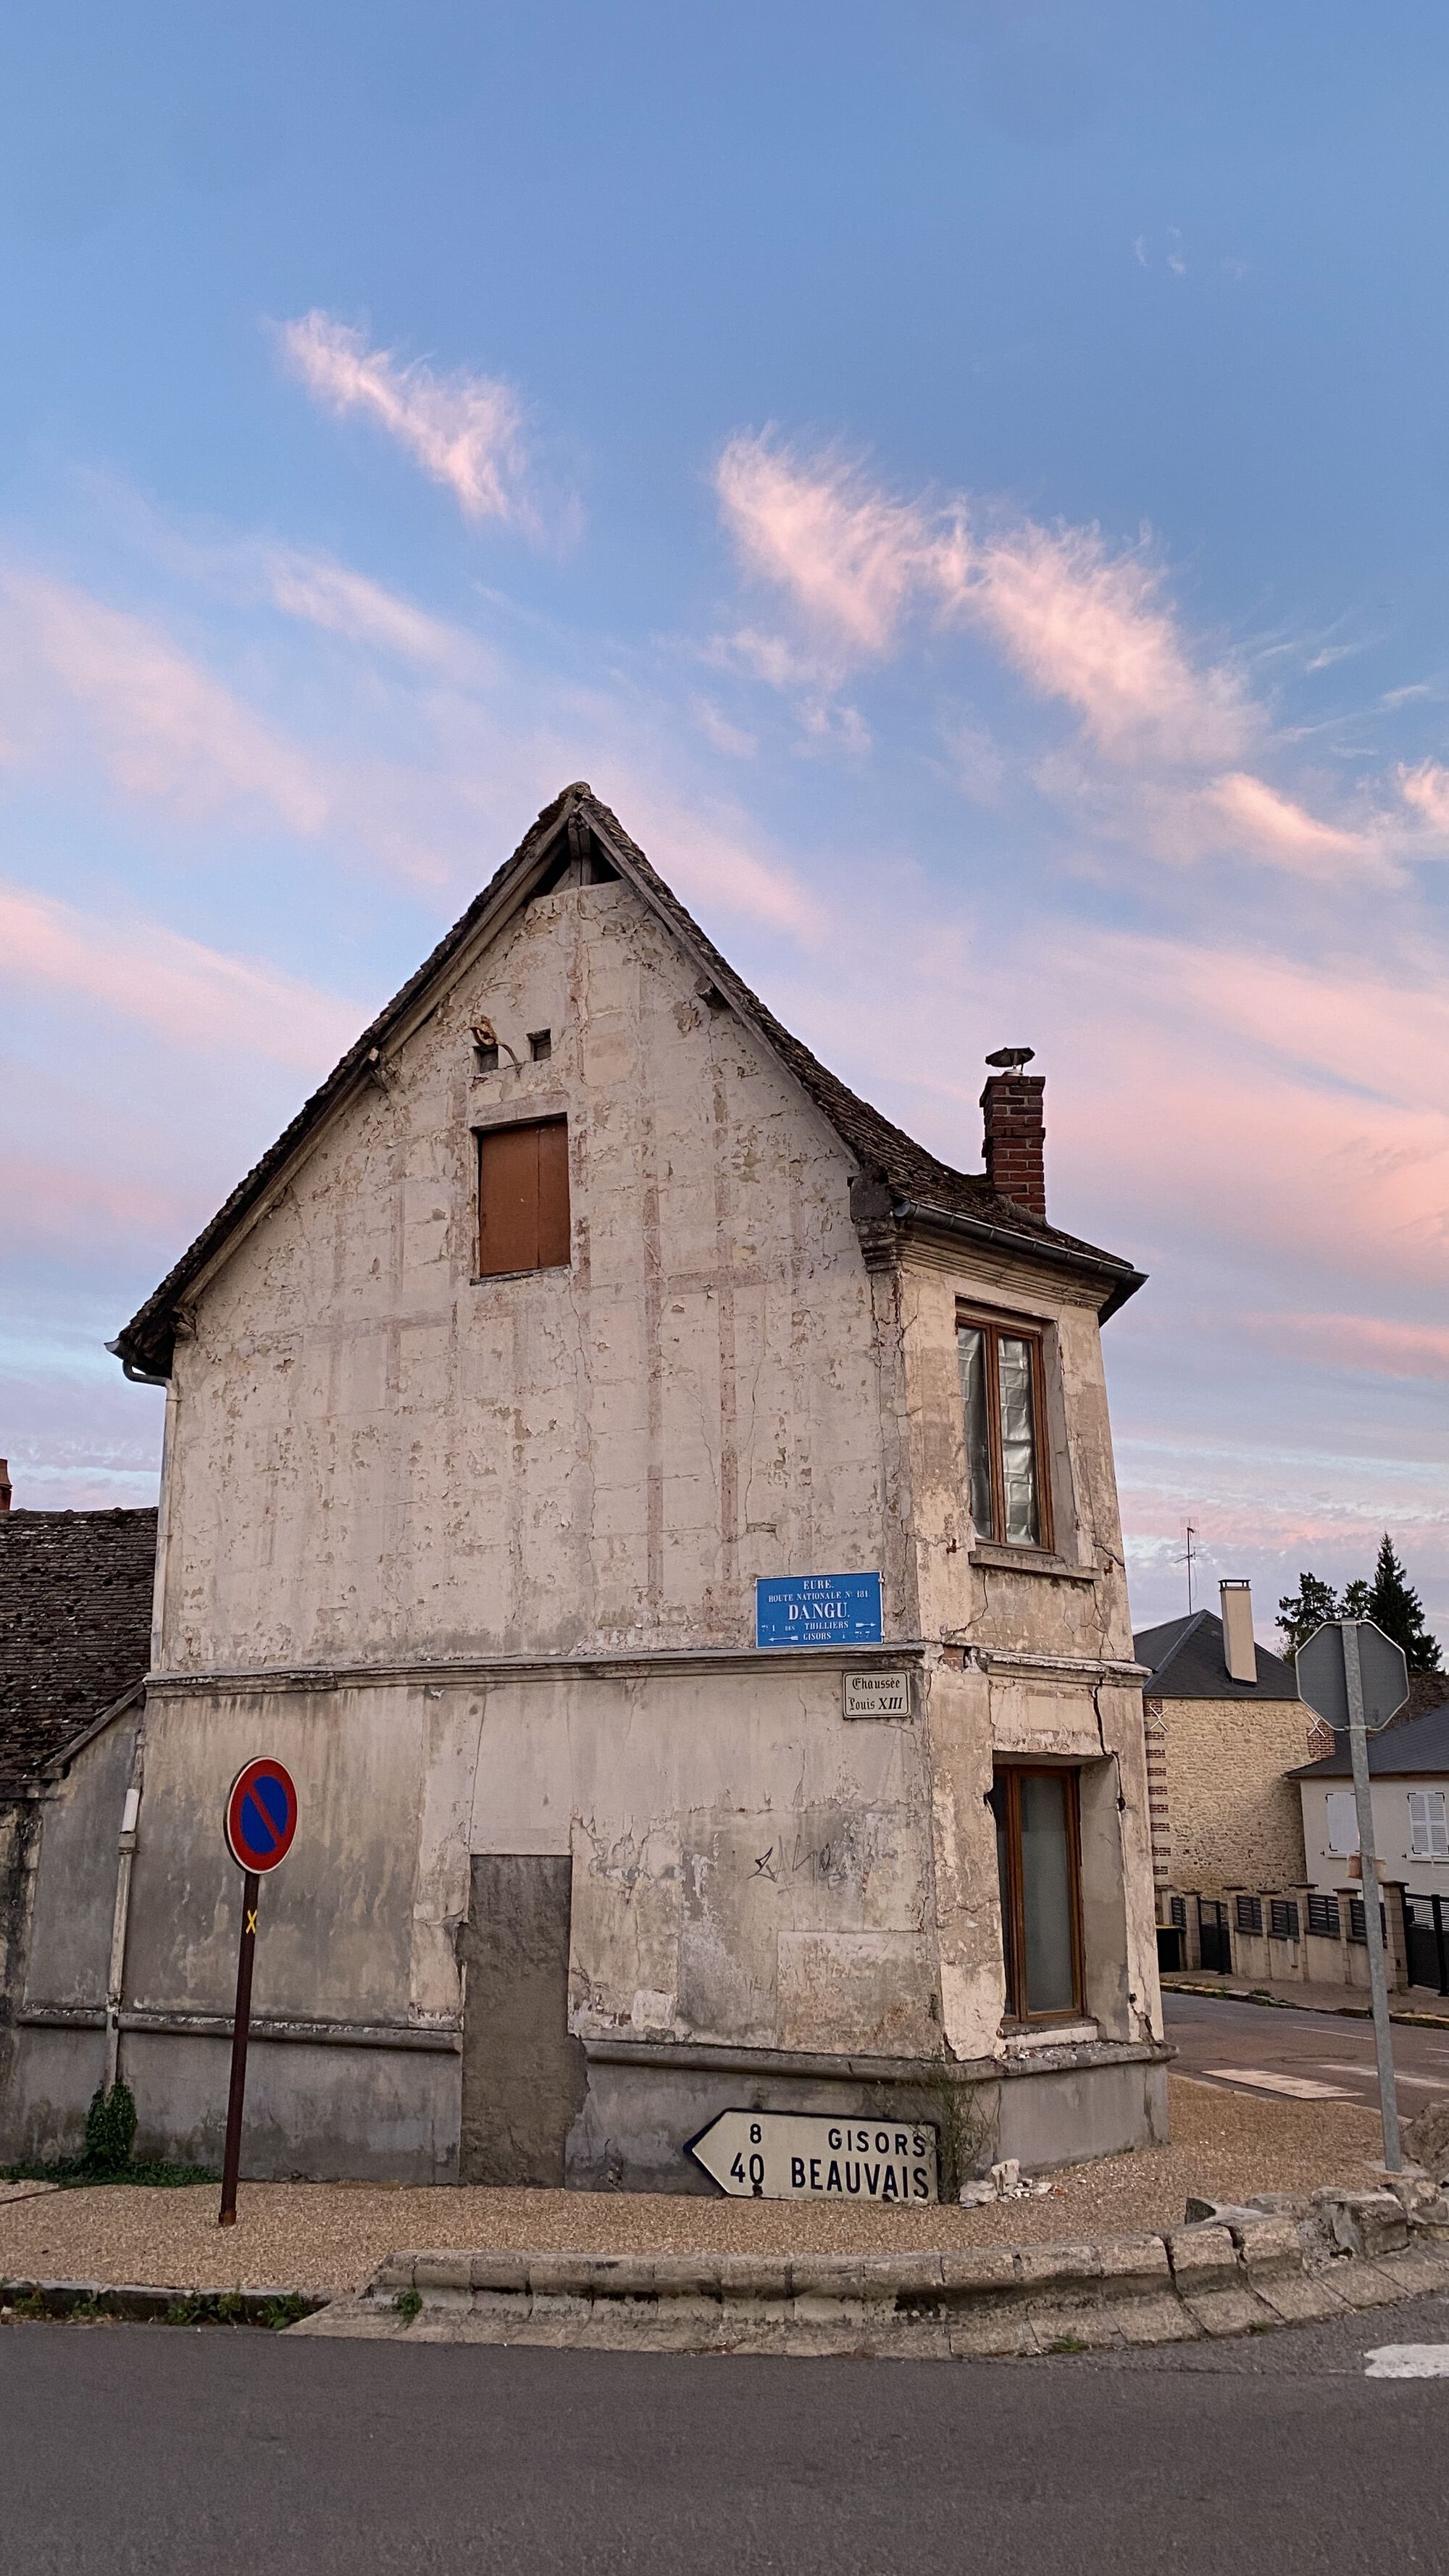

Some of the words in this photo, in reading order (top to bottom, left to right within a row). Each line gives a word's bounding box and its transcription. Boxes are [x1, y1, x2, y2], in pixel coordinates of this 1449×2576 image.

[797, 1591, 842, 1601] NATIONALE
[788, 1602, 851, 1621] DANGU.
[804, 1621, 849, 1631] THILLIERS
[803, 1631, 832, 1641] GISORS
[852, 1677, 901, 1690] Chaussée
[848, 1697, 875, 1711] Louis
[877, 1697, 903, 1710] XIII
[749, 2123, 762, 2144] 8
[827, 2128, 927, 2158] GISORS
[730, 2152, 765, 2185] 40
[790, 2157, 930, 2199] BEAUVAIS
